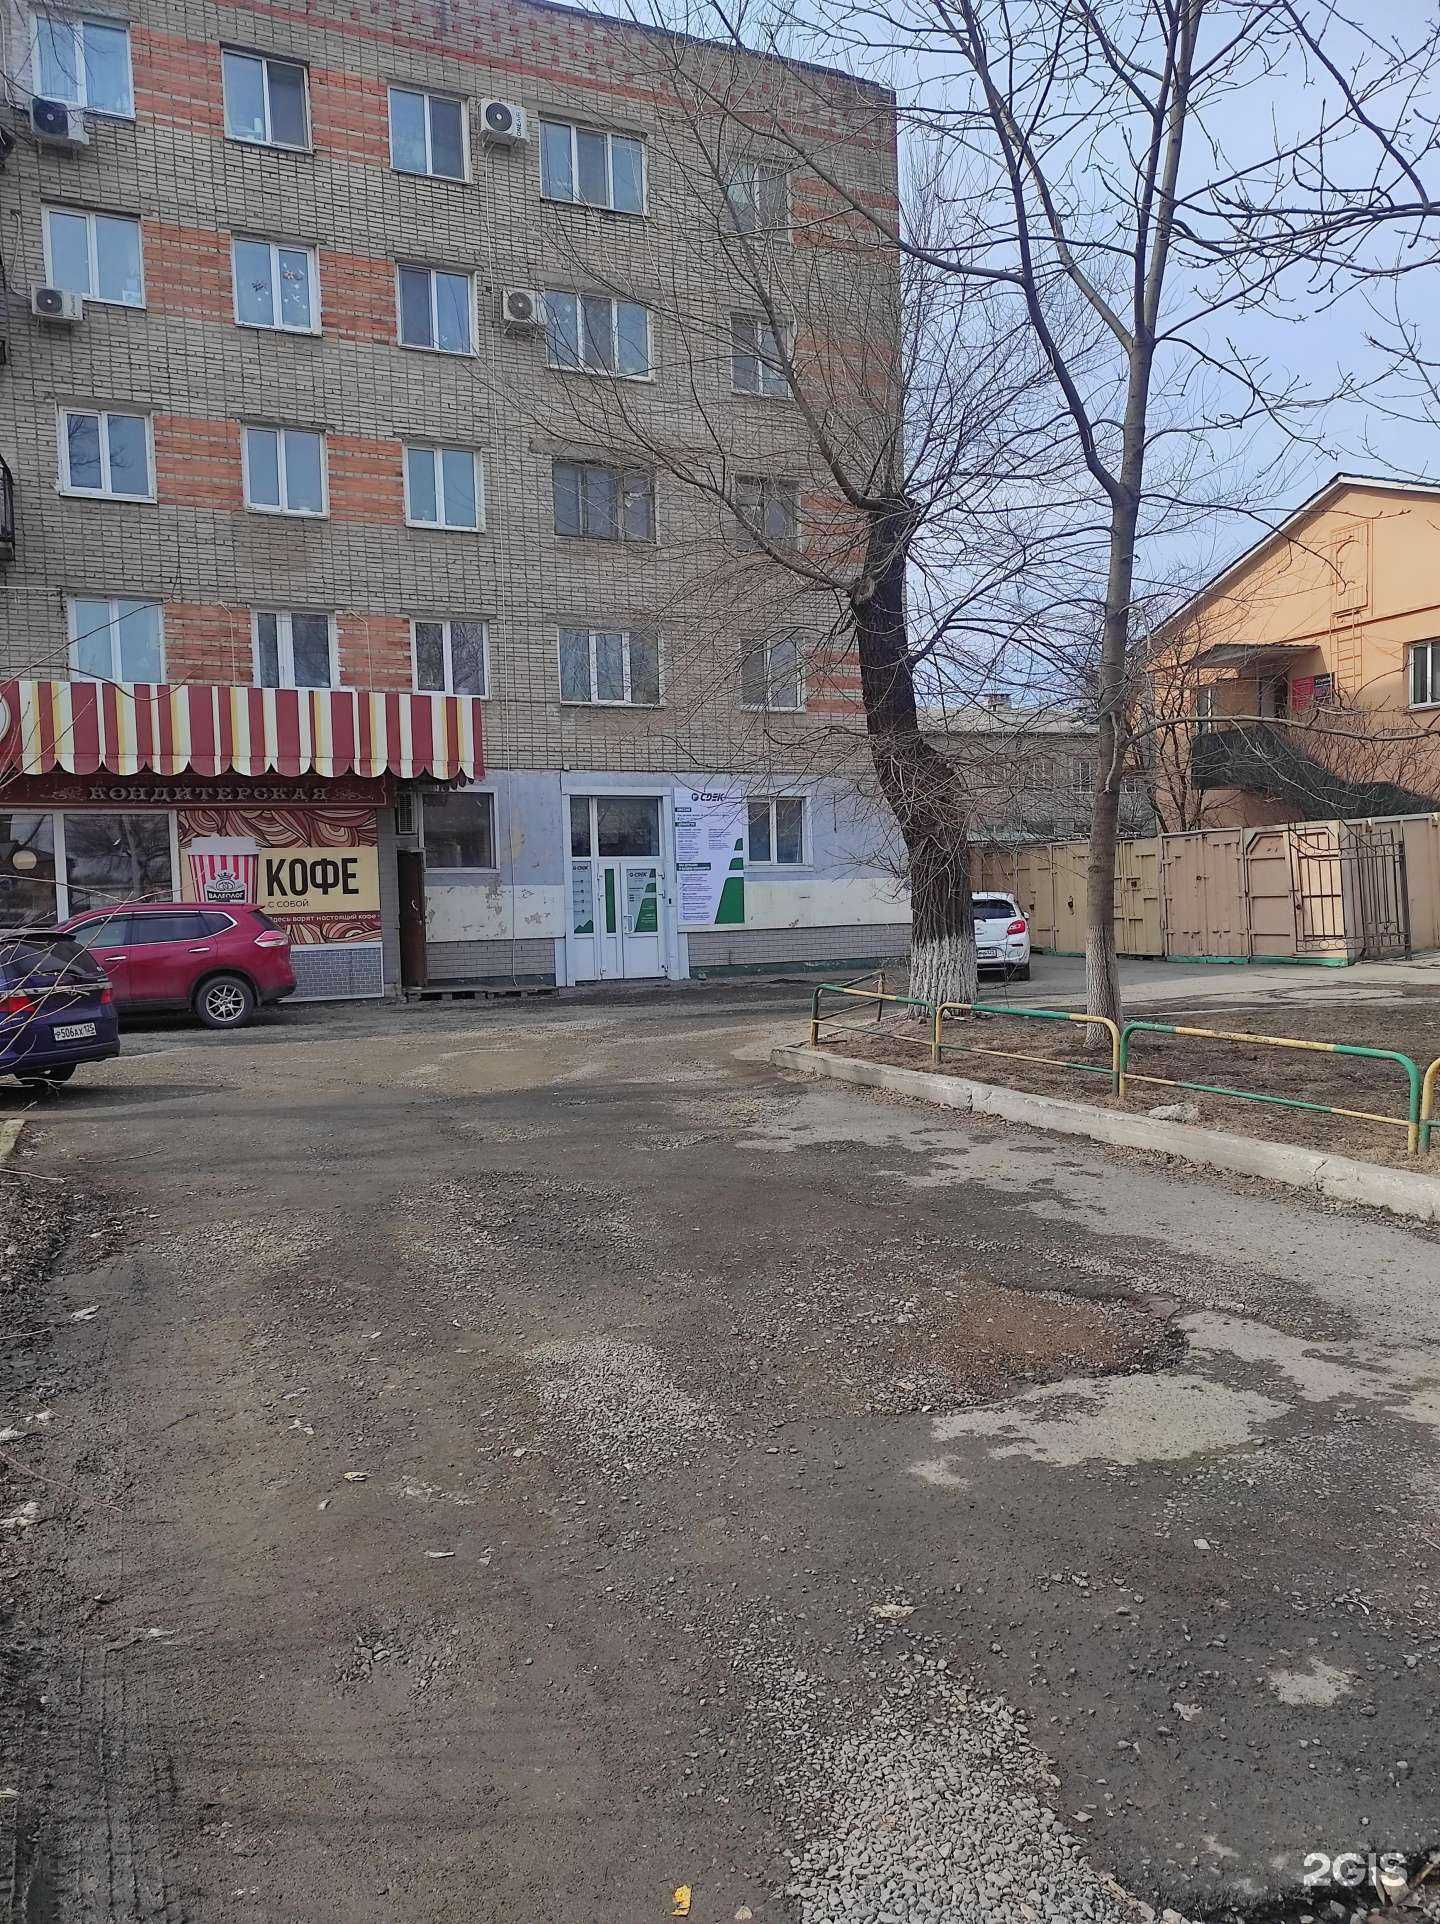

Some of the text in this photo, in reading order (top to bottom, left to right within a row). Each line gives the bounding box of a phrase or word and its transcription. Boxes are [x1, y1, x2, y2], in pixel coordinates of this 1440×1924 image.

[89, 786, 328, 801] КОНДИТЕРСКАЯ
[265, 857, 359, 897] КОФЕ
[276, 899, 309, 908] СОБОЙ
[316, 913, 357, 921] настоящий
